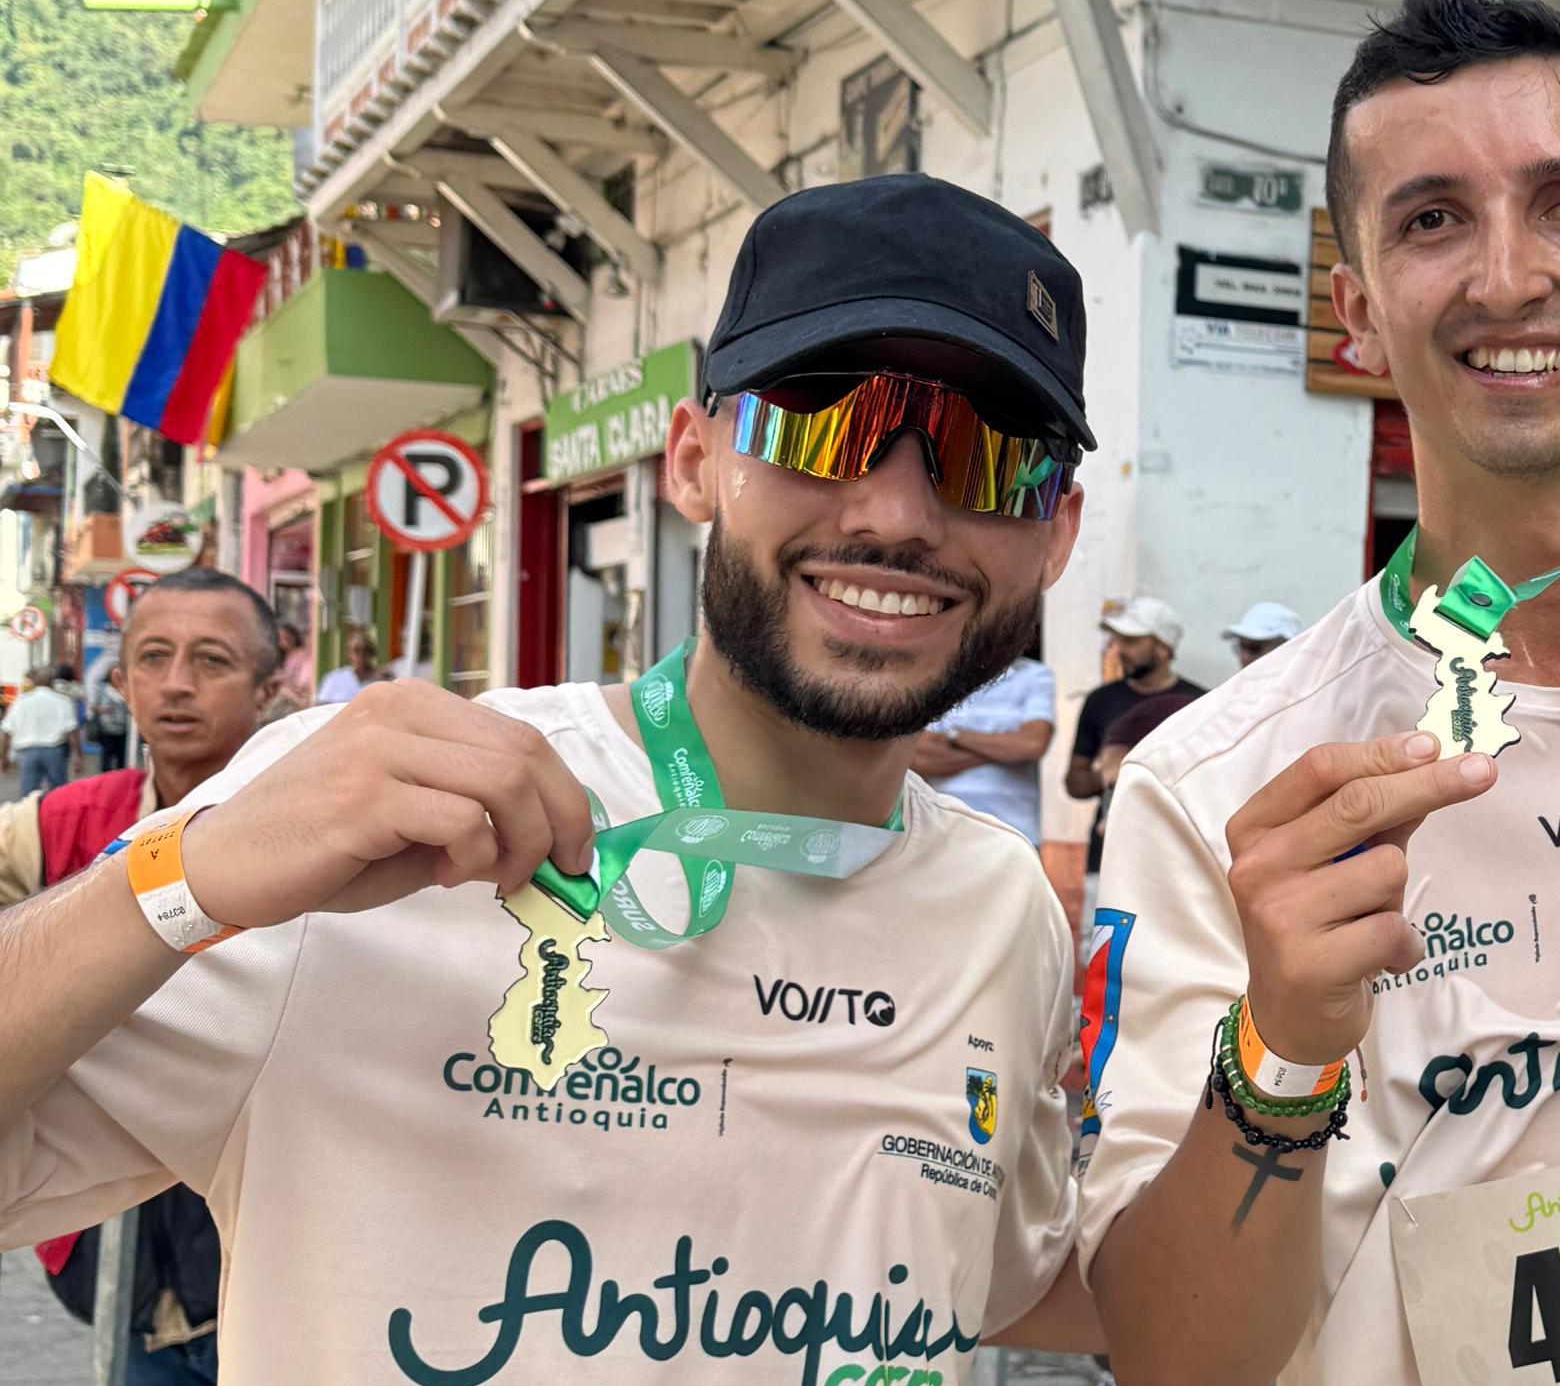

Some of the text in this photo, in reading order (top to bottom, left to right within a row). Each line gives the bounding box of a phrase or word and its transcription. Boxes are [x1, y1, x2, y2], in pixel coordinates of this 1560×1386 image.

[606, 395, 671, 464] CLARA
[672, 747, 704, 808] Comfenalc
[483, 1097, 669, 1131] Antioquia
